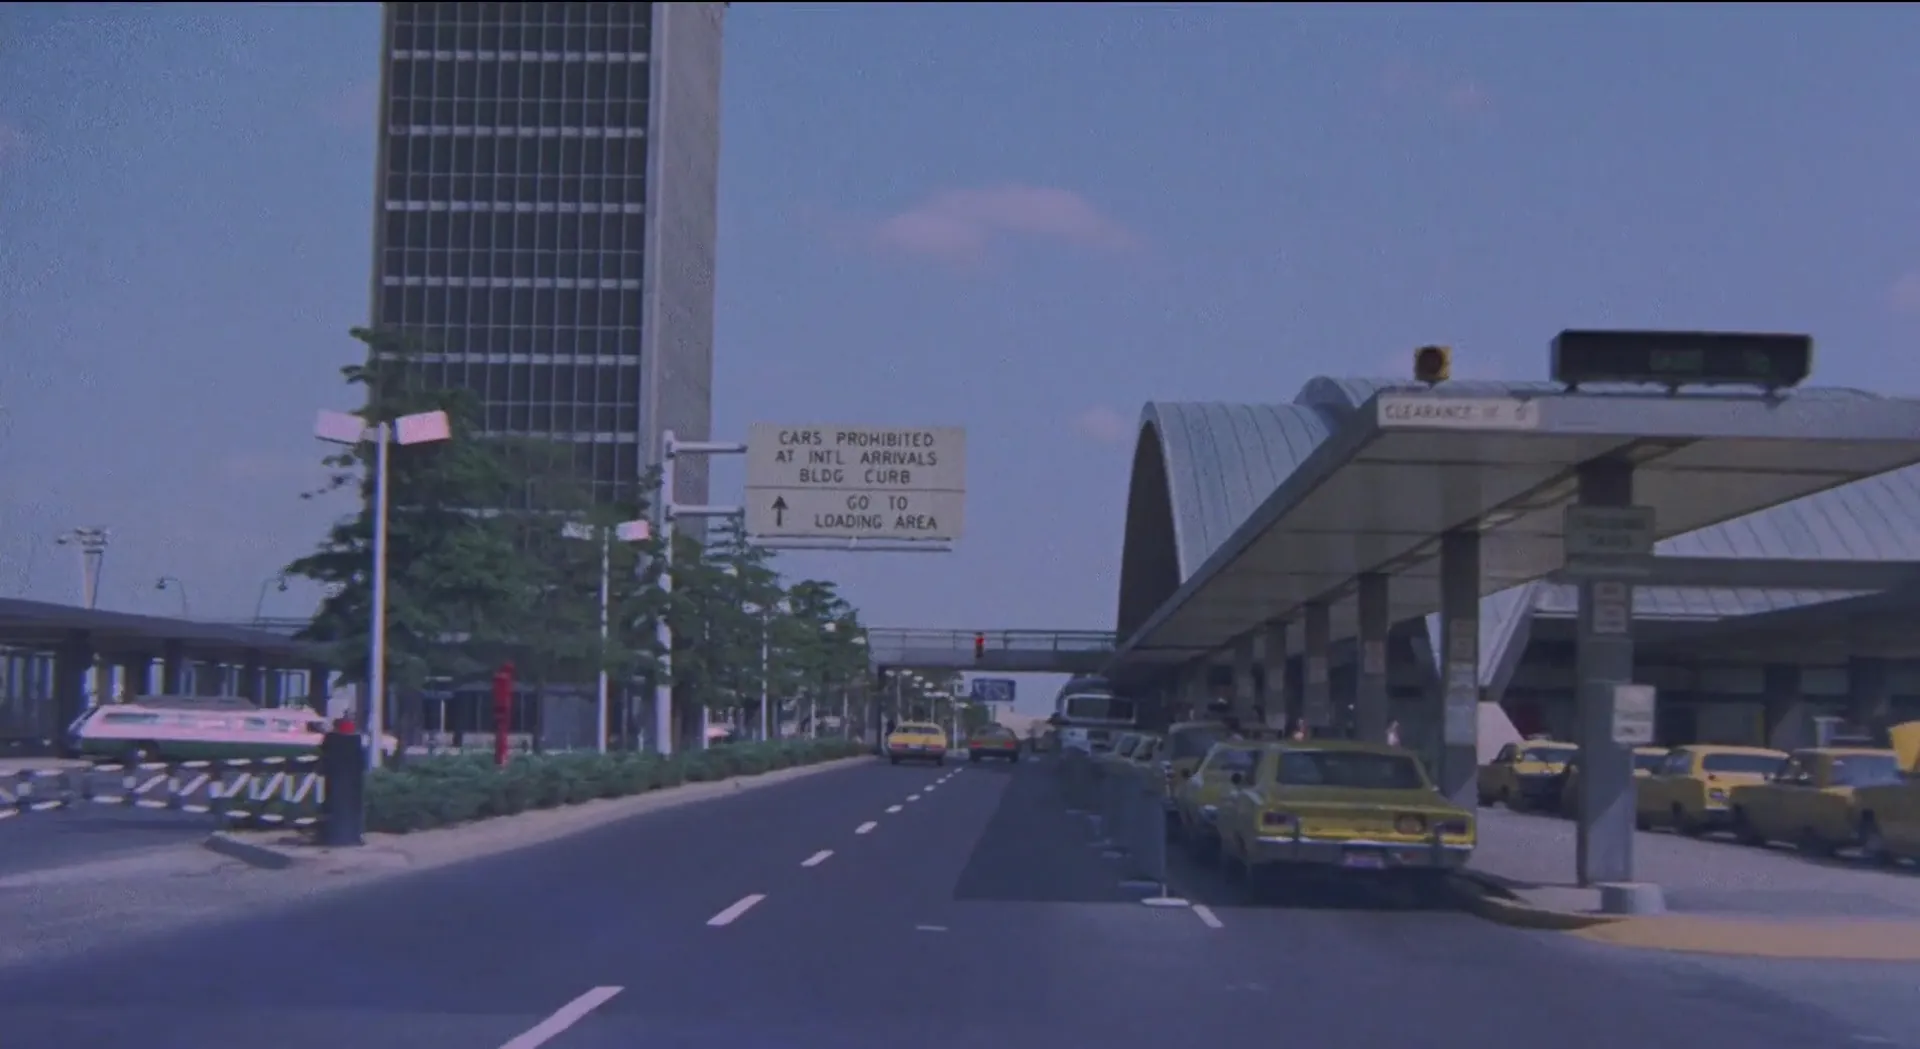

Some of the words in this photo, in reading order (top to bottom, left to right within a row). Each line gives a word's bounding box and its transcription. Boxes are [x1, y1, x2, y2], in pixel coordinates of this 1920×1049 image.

[779, 431, 822, 446] CARS
[836, 432, 934, 447] PROHIBITED
[775, 450, 794, 463] AT
[860, 451, 938, 466] ARRIVALS
[799, 469, 844, 483] BLDG
[864, 469, 911, 484] CURB
[846, 495, 870, 510] GO
[888, 496, 909, 511] TO
[814, 514, 883, 529] LOADING
[894, 515, 938, 530] AREA
